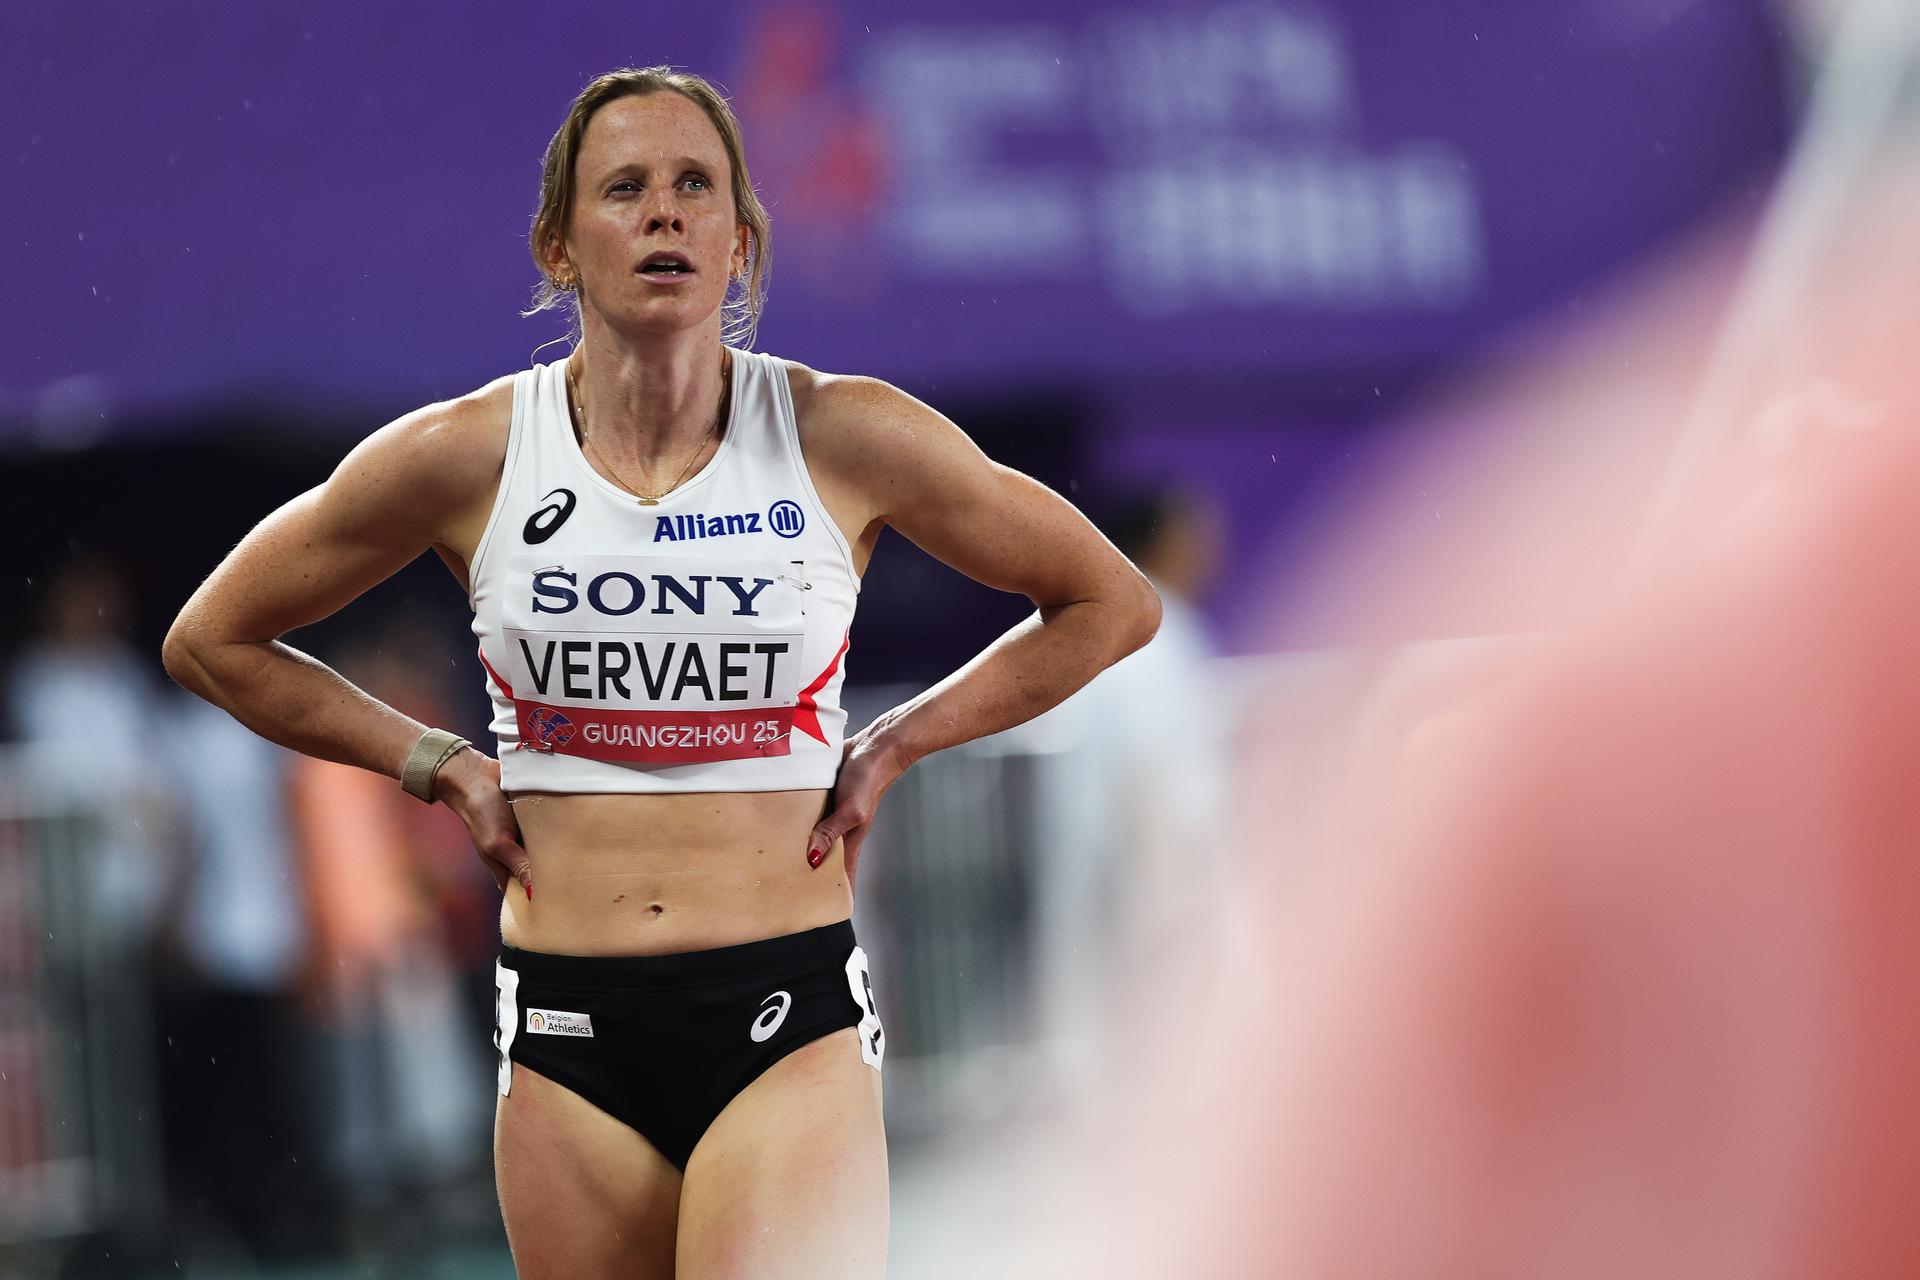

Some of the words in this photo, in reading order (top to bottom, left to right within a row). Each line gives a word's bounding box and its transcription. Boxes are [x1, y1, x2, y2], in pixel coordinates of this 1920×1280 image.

[653, 513, 762, 542] Allianz
[532, 571, 774, 616] SONY
[519, 638, 789, 701] VERVAET
[583, 722, 747, 748] GUANGZHOU
[753, 720, 780, 742] 25
[547, 1013, 572, 1022] Belgian
[547, 1022, 591, 1035] Athletics
